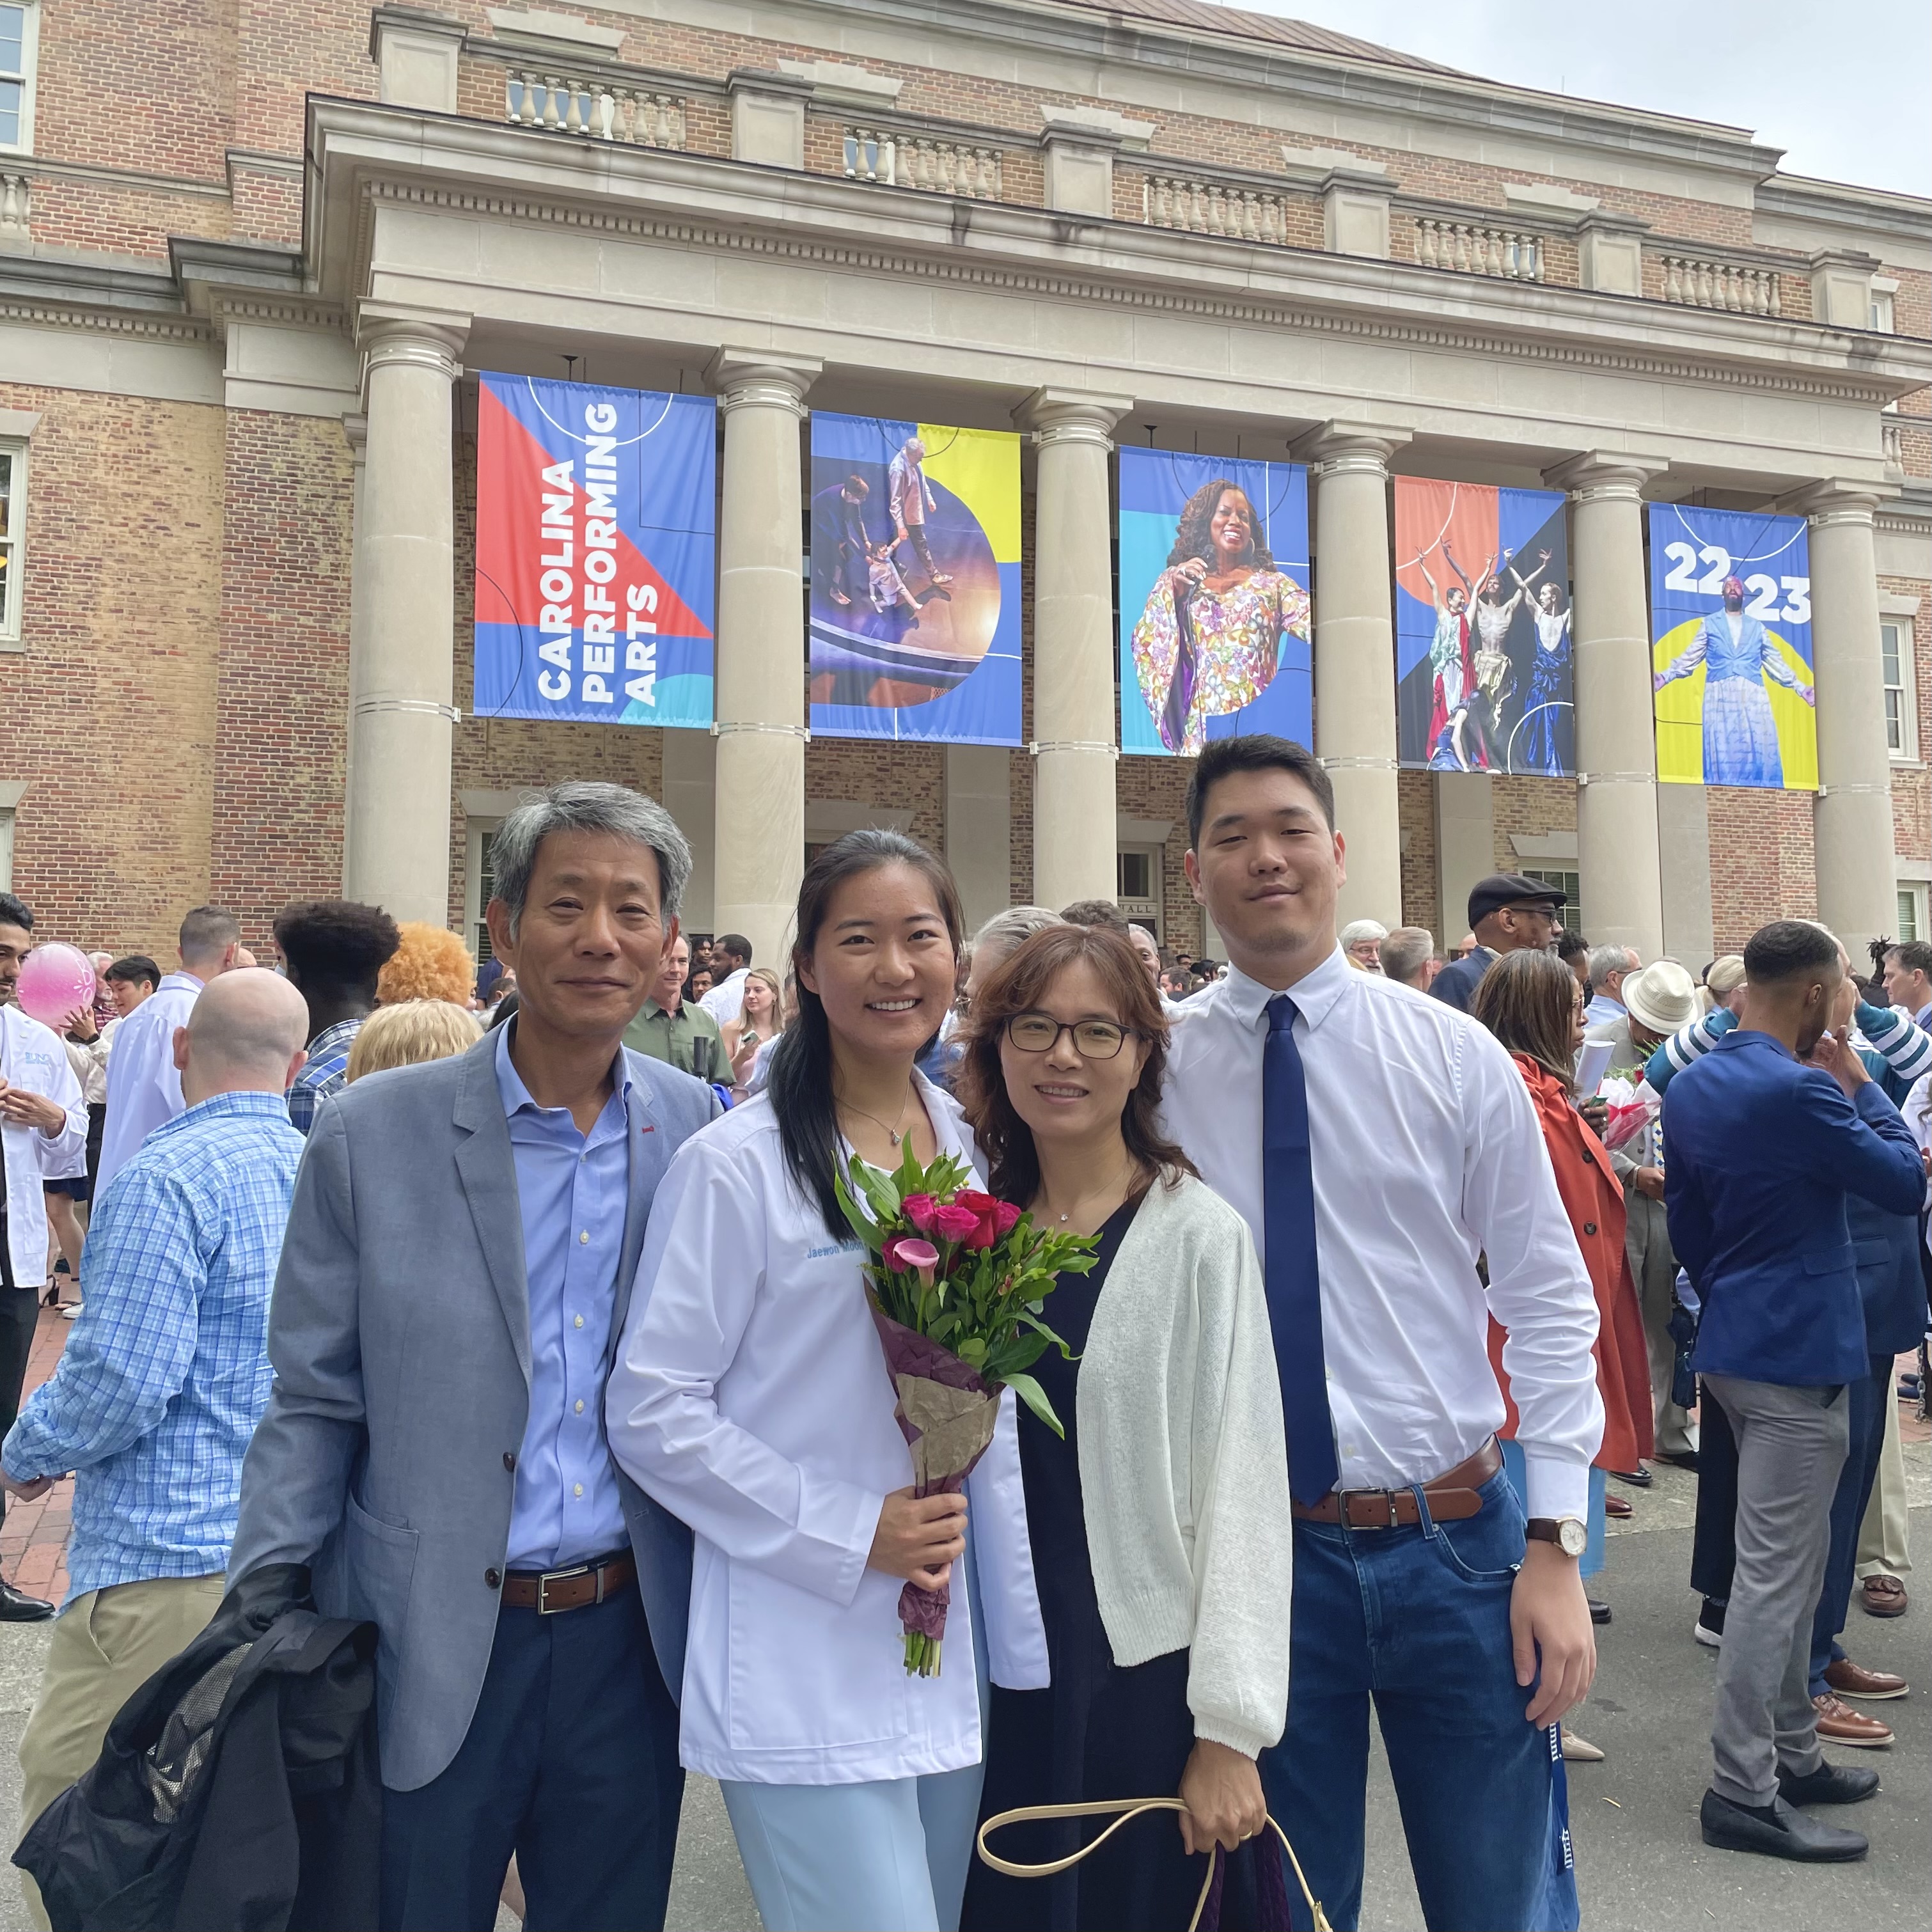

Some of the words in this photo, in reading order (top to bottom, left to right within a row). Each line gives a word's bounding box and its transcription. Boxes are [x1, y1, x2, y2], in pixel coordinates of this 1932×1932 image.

[538, 459, 574, 701] CAROLINA
[582, 403, 618, 703] PERFORMING
[1664, 541, 1731, 595] 22
[1743, 573, 1812, 624] 23
[625, 585, 659, 707] ARTS
[807, 1245, 840, 1259] Jaewon
[843, 1241, 865, 1253] Moon
